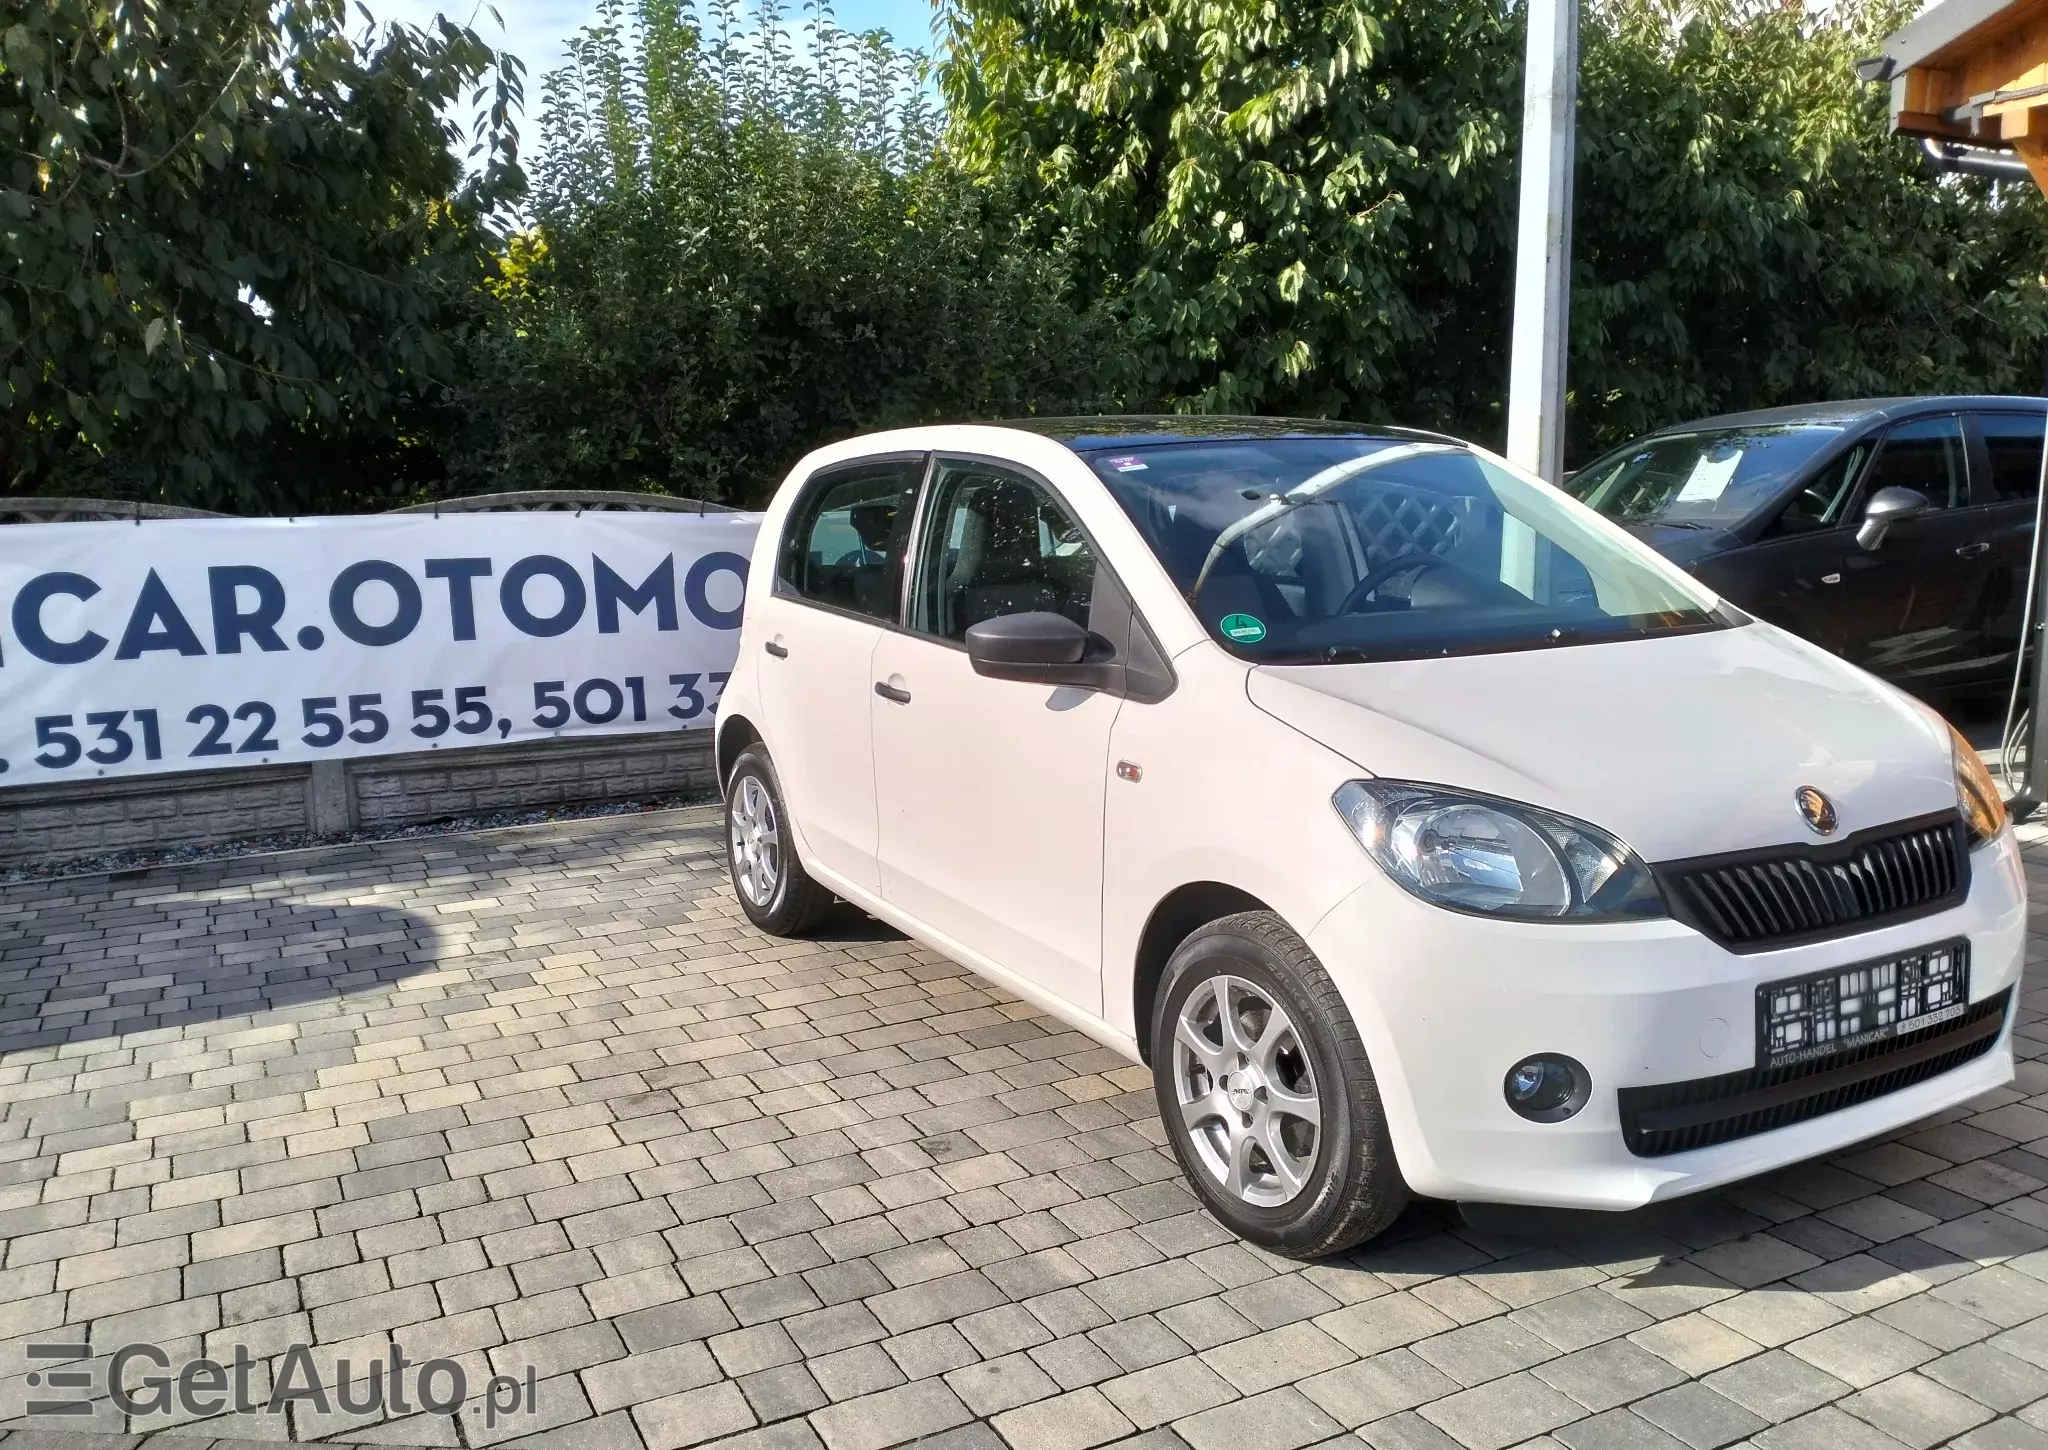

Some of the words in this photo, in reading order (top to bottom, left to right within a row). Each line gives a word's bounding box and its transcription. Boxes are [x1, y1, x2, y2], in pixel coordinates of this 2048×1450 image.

[0, 551, 751, 667] CAR.OTOMO
[34, 708, 163, 769] 531
[185, 700, 280, 758] 22
[300, 693, 390, 748] 55
[409, 685, 513, 740] 55,
[531, 675, 648, 732] 501
[1908, 1017, 1926, 1030] 501
[1927, 1011, 1944, 1025] 332
[1944, 1005, 1961, 1018] 703
[1769, 1043, 1837, 1068] AUTO-HANDEL
